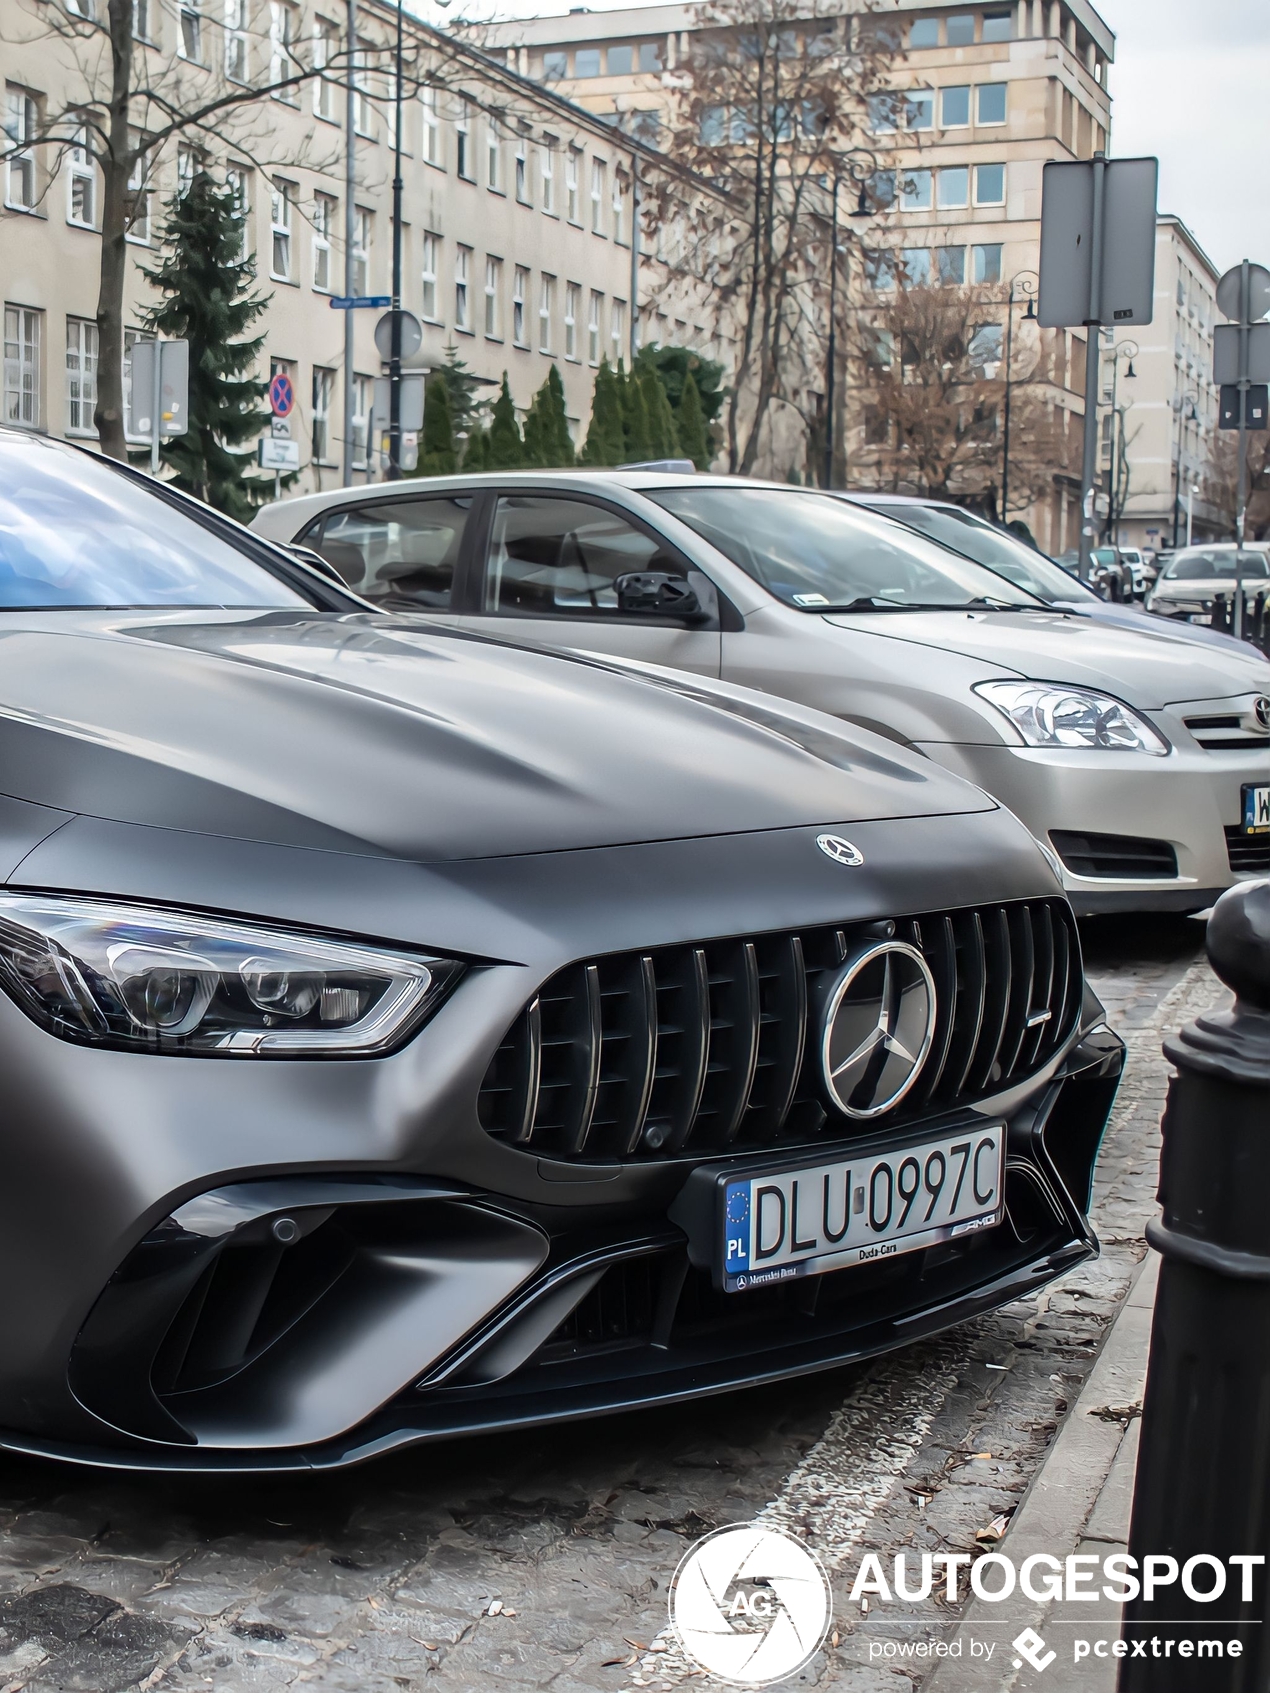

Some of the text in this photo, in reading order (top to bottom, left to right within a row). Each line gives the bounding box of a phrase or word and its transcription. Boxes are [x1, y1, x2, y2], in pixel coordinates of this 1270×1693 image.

[754, 1136, 996, 1262] DLU 0997C
[726, 1239, 746, 1260] PL
